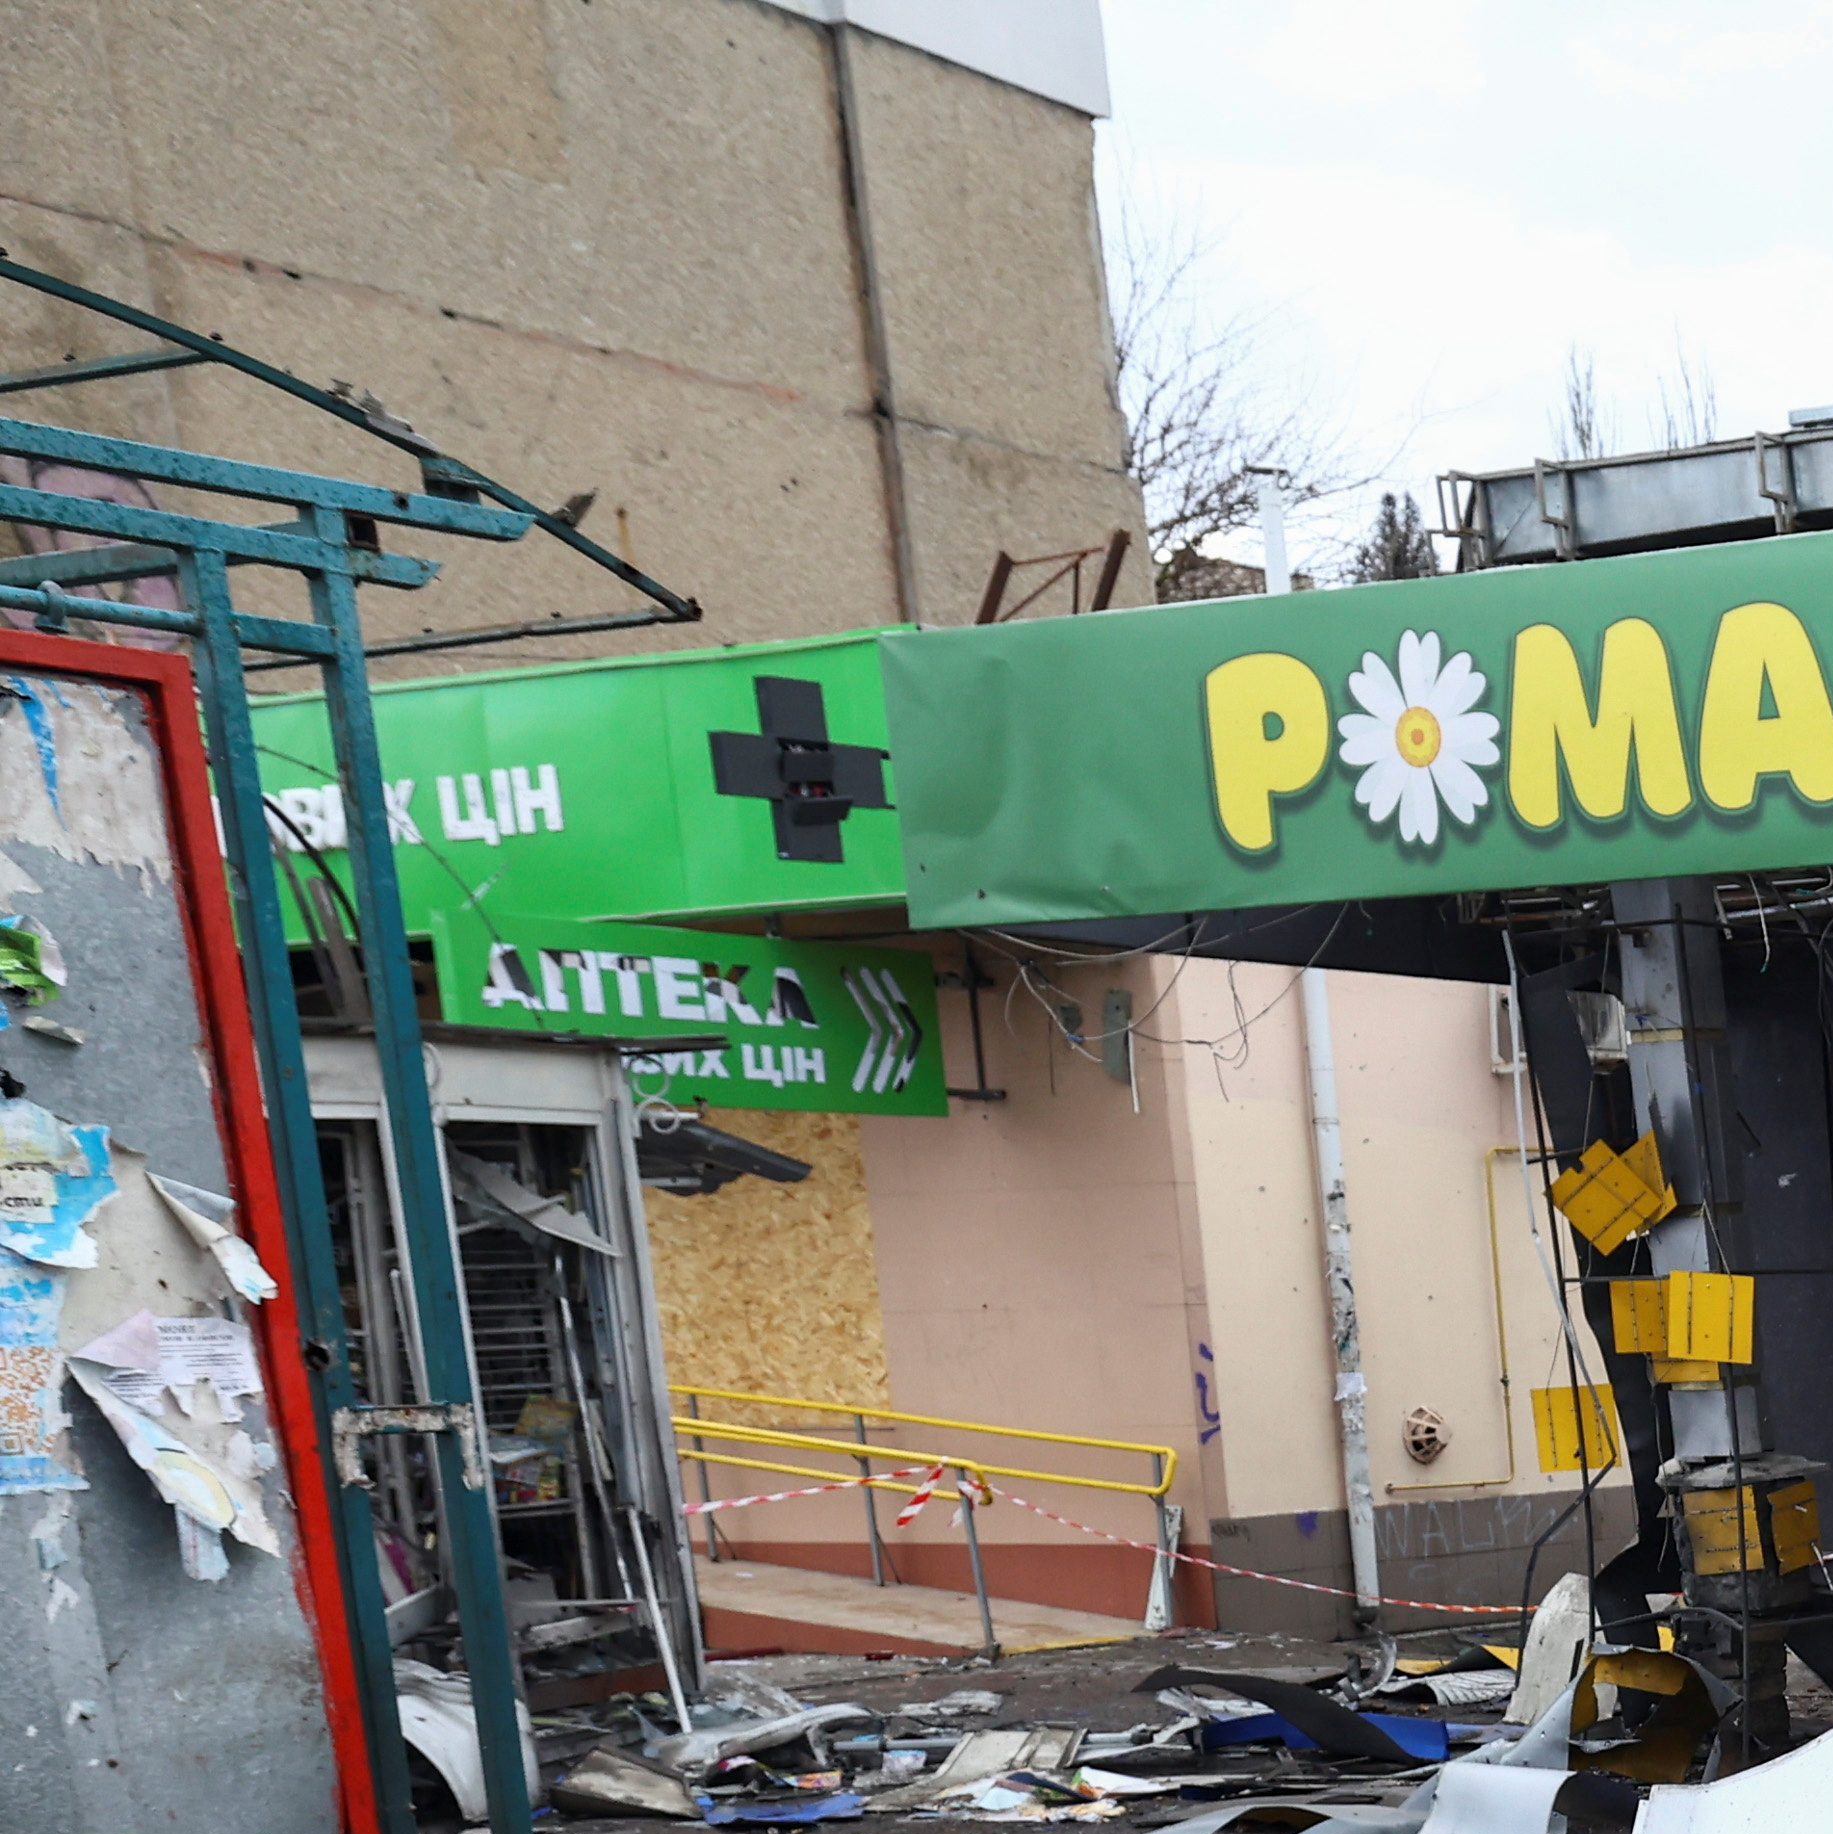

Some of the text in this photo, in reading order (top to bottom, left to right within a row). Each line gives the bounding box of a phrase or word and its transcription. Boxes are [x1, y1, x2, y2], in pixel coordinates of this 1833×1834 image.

[436, 763, 565, 847] ЦІН
[482, 942, 820, 1029] АПТЕКА
[741, 1043, 826, 1088] ЦІН
